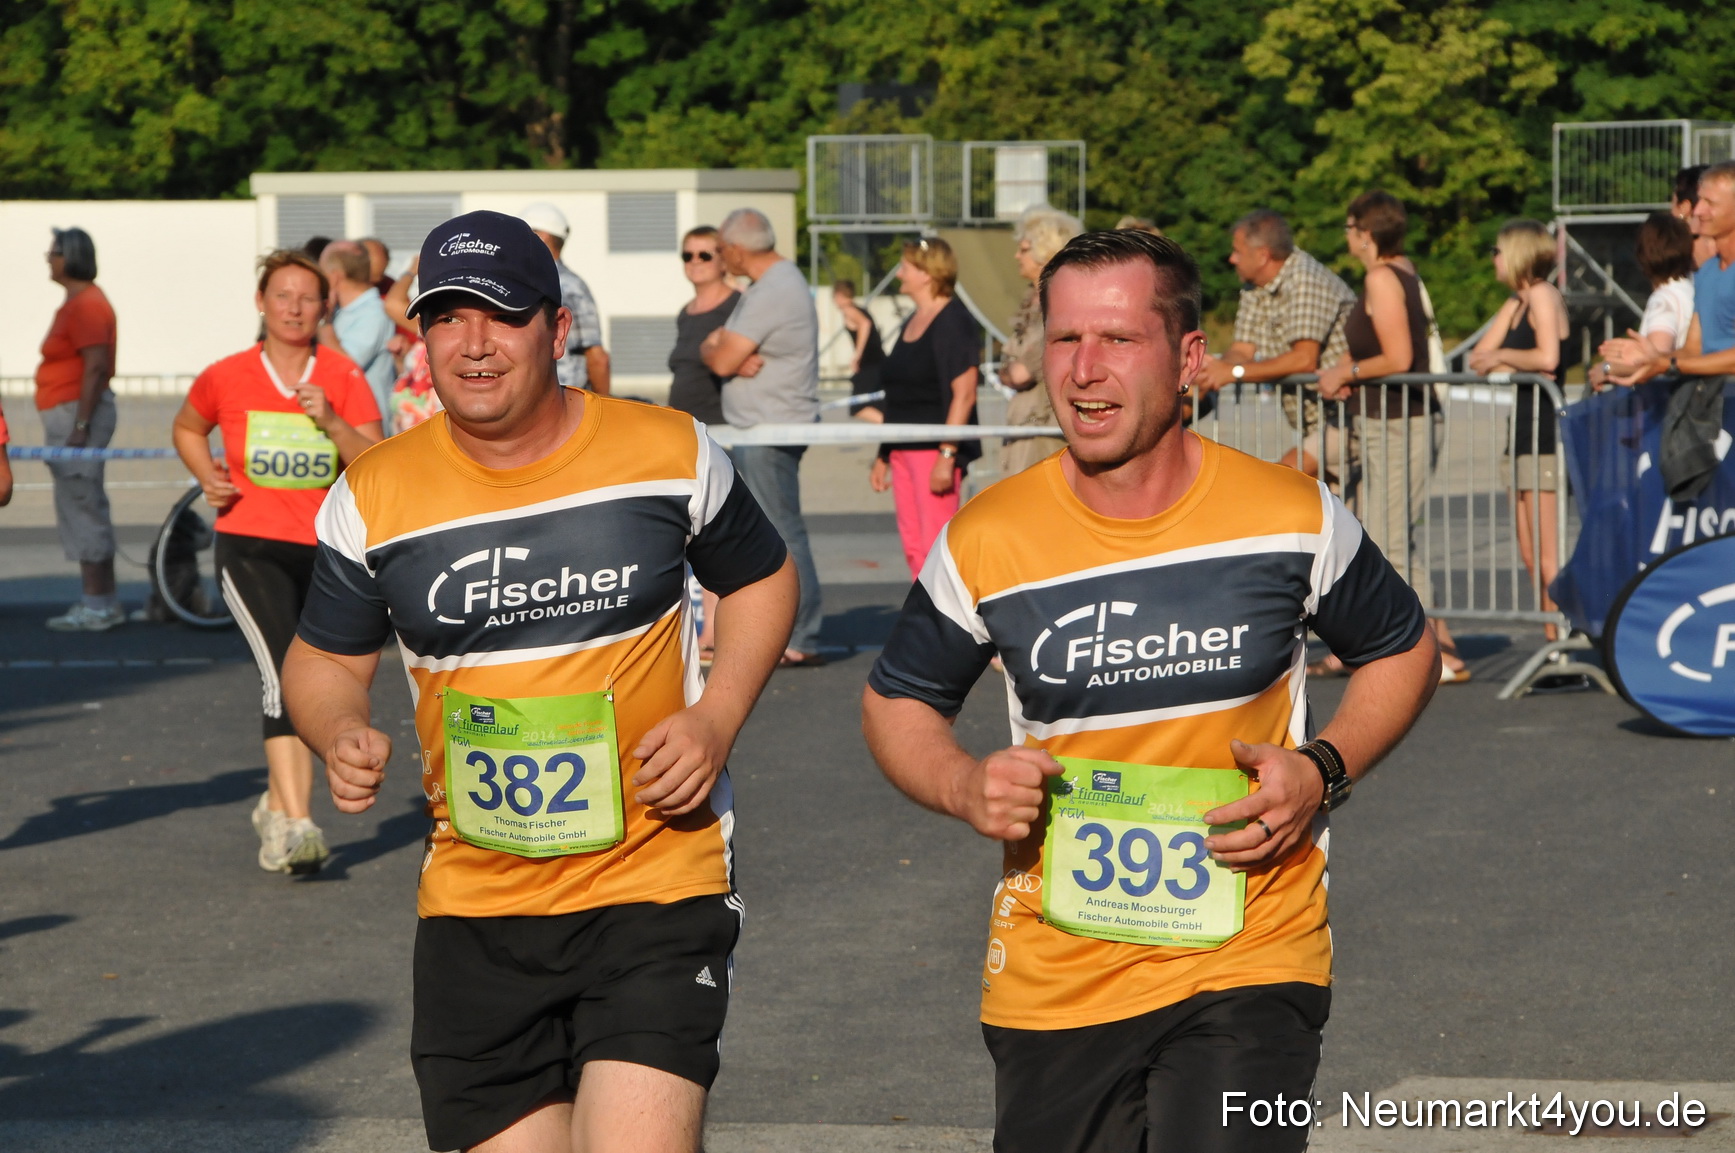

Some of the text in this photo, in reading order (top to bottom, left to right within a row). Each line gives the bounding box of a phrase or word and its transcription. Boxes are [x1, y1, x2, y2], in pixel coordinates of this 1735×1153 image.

[448, 239, 501, 252] Fischer
[451, 248, 495, 256] AUTOMOBILE
[251, 450, 331, 478] 5085
[464, 564, 639, 614] Fischer
[484, 594, 629, 628] AUTOMOBILE
[1066, 623, 1249, 672] Fischer
[1086, 655, 1242, 688] AUTOMOBILE
[463, 718, 520, 736] firmenlauf
[522, 730, 556, 742] 2014
[466, 750, 589, 817] 382
[1078, 787, 1147, 806] firmenlauf
[1148, 803, 1184, 815] 2014
[494, 816, 567, 830] Thomas Fischer
[479, 826, 587, 843] Fischer Automobile GmbH
[1072, 823, 1211, 901] 393
[1086, 897, 1197, 917] Andreas Moosburger
[1078, 911, 1203, 931] Fischer Automobile GmbH
